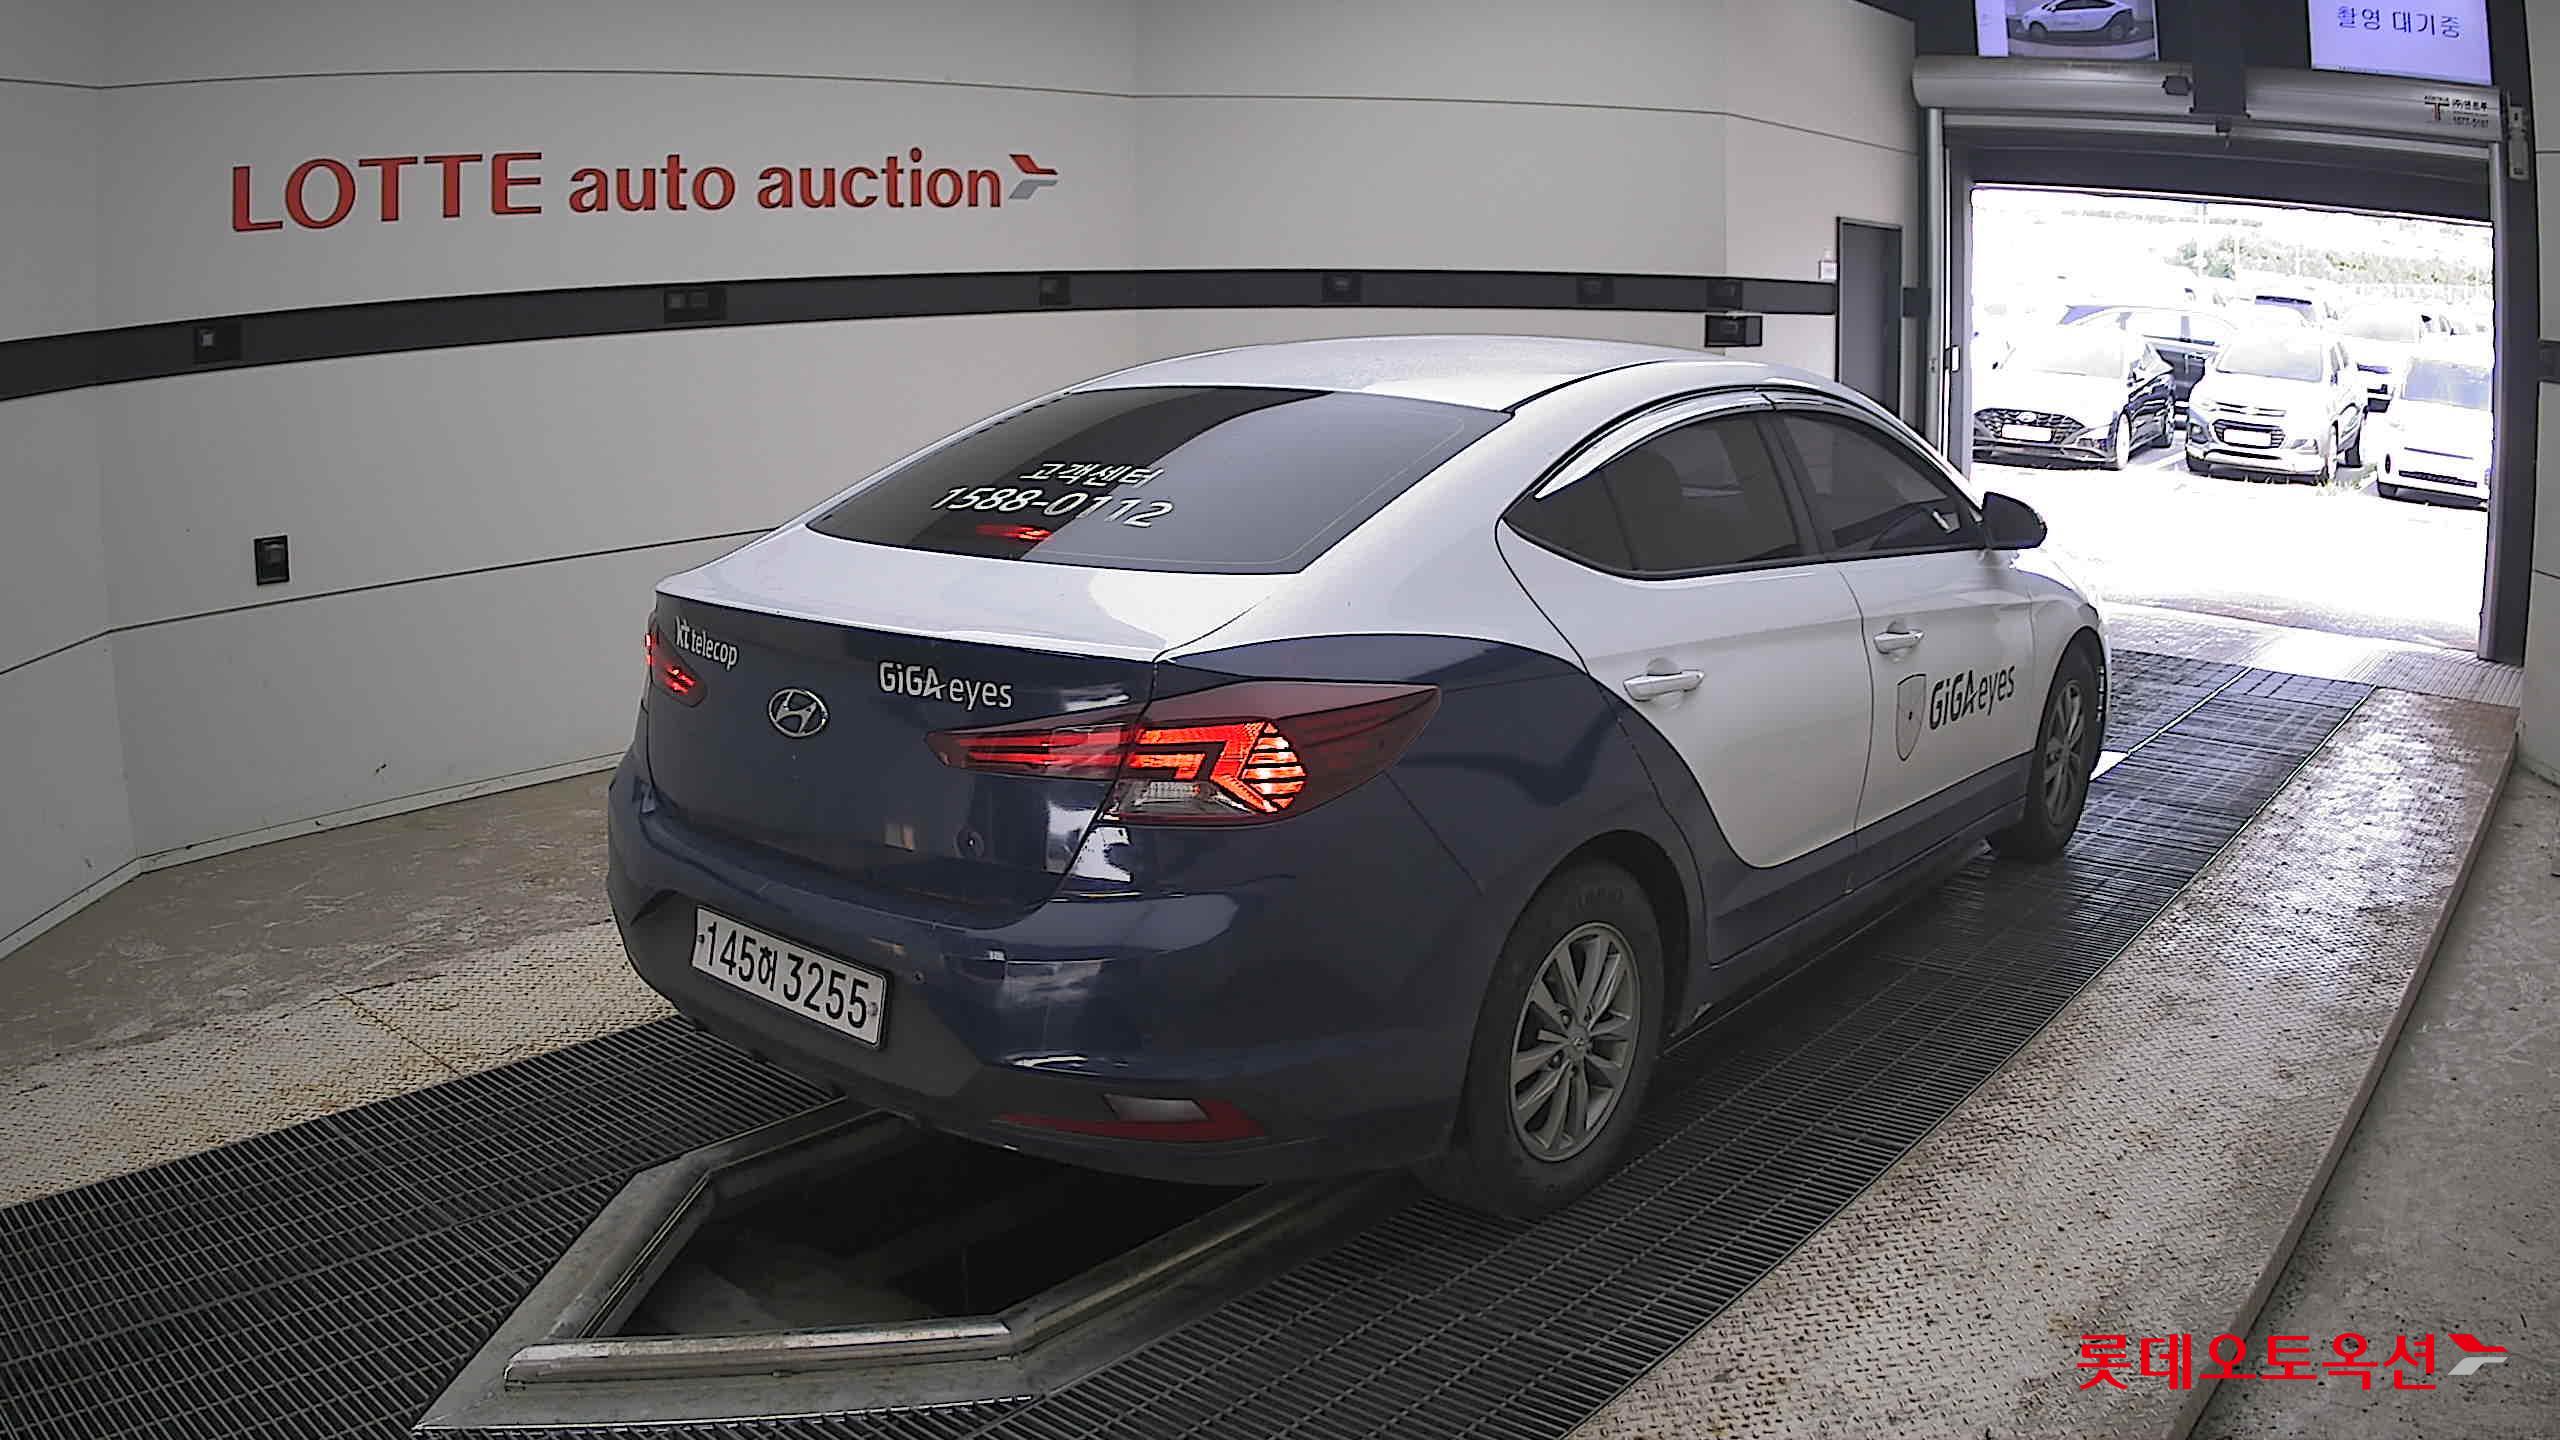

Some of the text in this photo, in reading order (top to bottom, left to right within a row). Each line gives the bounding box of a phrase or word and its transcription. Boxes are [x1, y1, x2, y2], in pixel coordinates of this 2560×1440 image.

[2338, 6, 2461, 39] 촬영 대기중
[232, 147, 1001, 232] LOTTE auto auction
[1019, 462, 1164, 488] 고객센터
[931, 486, 1174, 528] 1588-0112
[674, 615, 738, 671] kt telecop
[879, 661, 1012, 711] GiGA eyes
[1929, 665, 2015, 730] GiGA eyes
